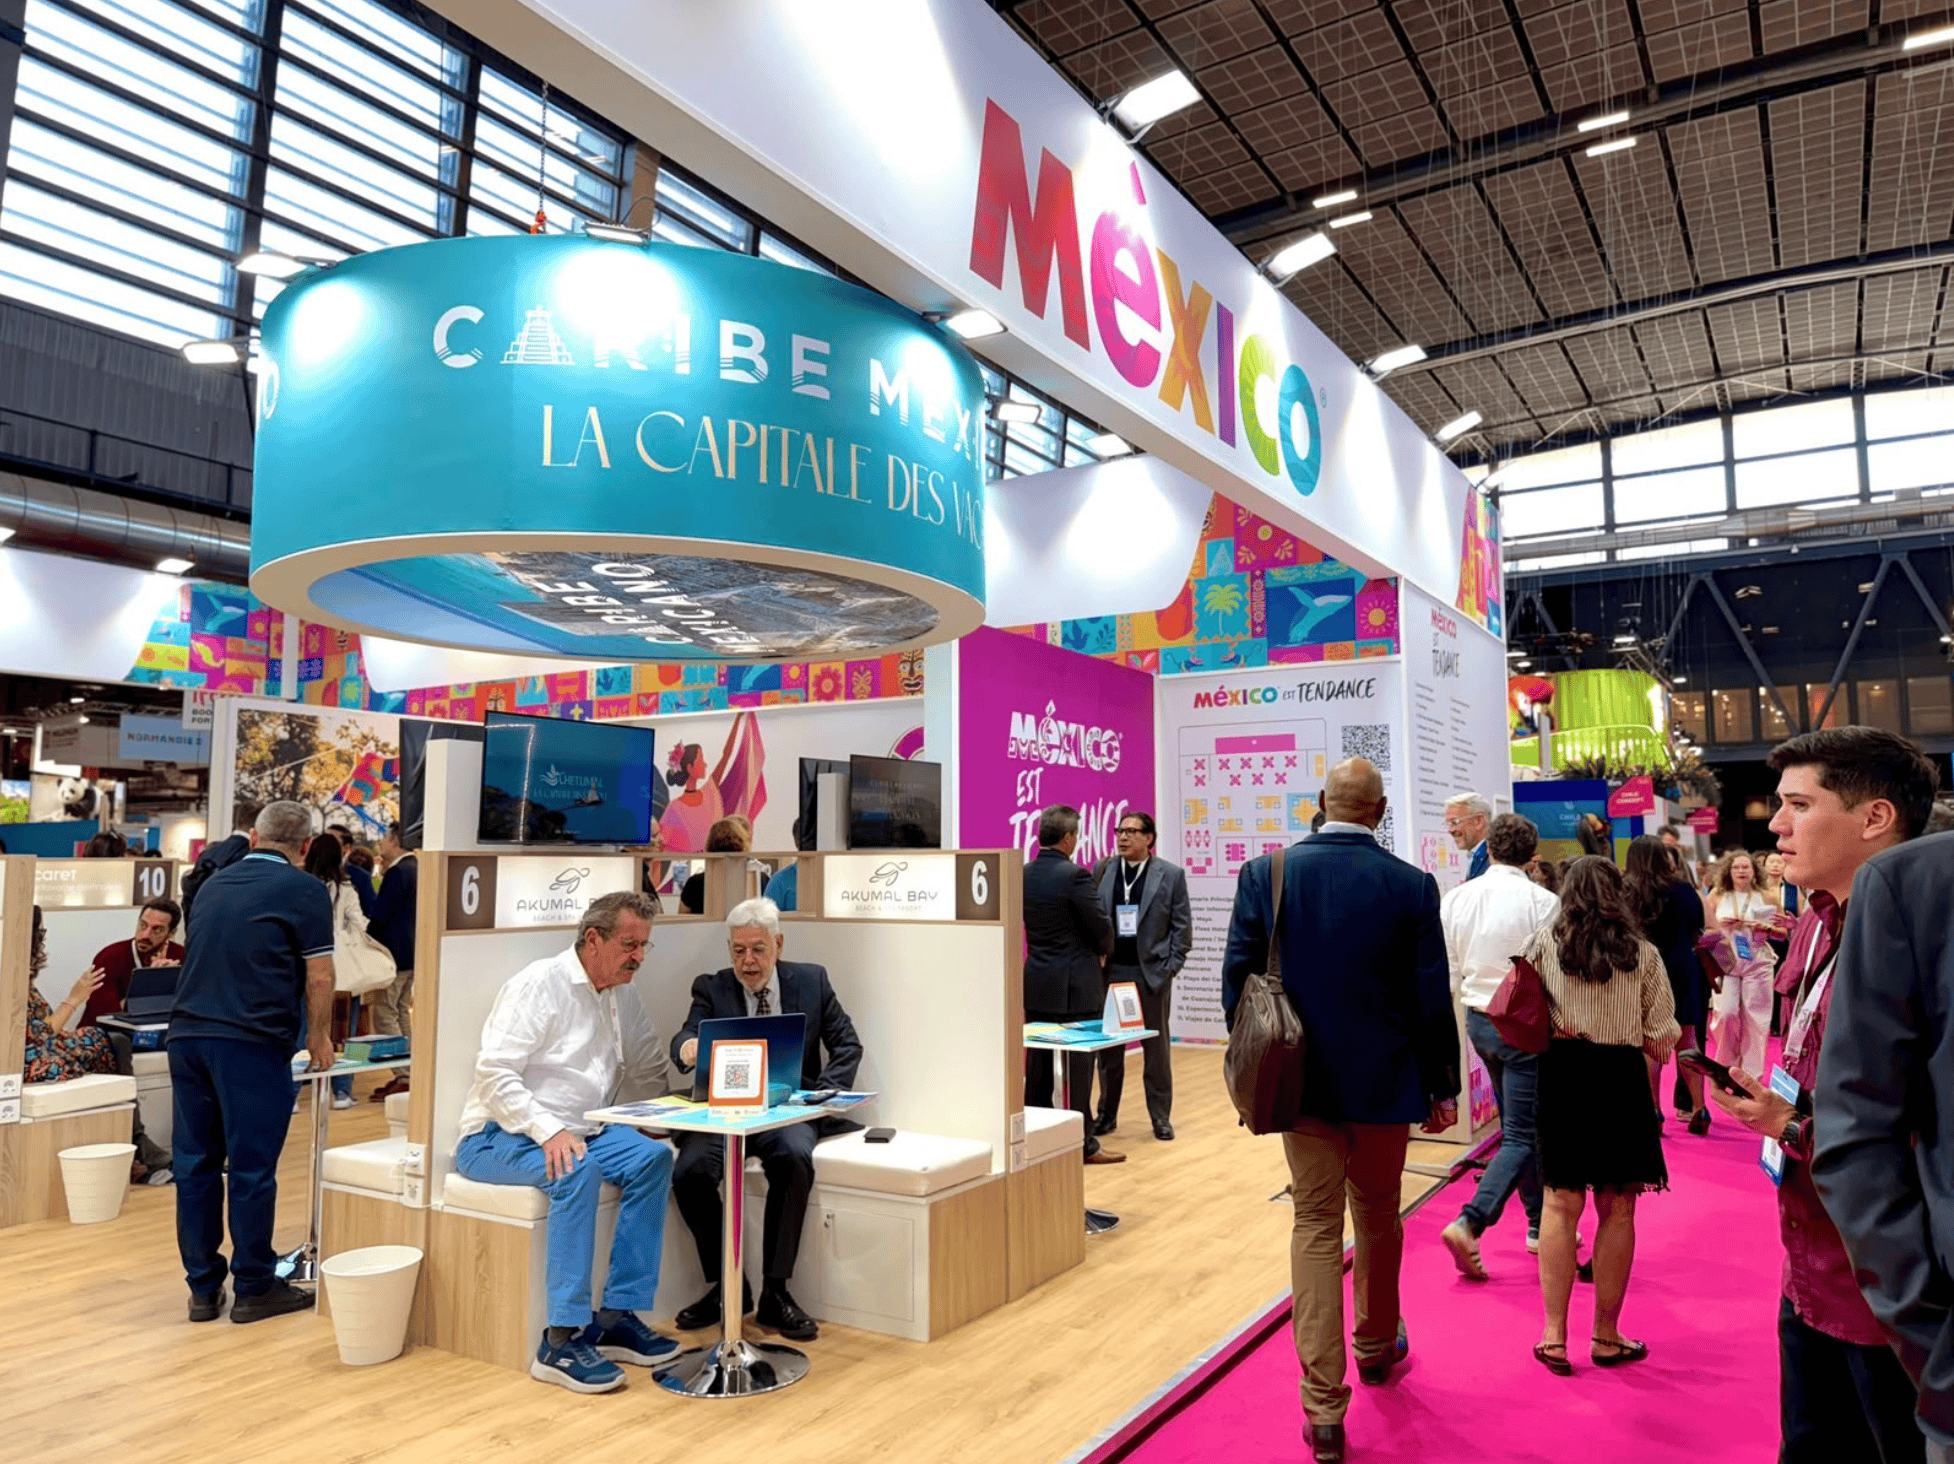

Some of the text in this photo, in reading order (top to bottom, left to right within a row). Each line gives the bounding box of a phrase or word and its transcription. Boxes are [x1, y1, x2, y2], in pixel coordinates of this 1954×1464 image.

[542, 404, 611, 469] LA
[635, 410, 872, 504] CAPITALE
[887, 454, 945, 527] DES
[1282, 689, 1295, 701] EST
[1297, 677, 1377, 704] TENDANCE
[1016, 766, 1044, 807] EST
[1008, 797, 1129, 867] TEANC
[139, 866, 166, 898] 10
[461, 865, 480, 915] 6
[841, 890, 938, 902] AKUMAL BAY
[971, 860, 989, 906] 6
[516, 898, 583, 911] AKUMAL
